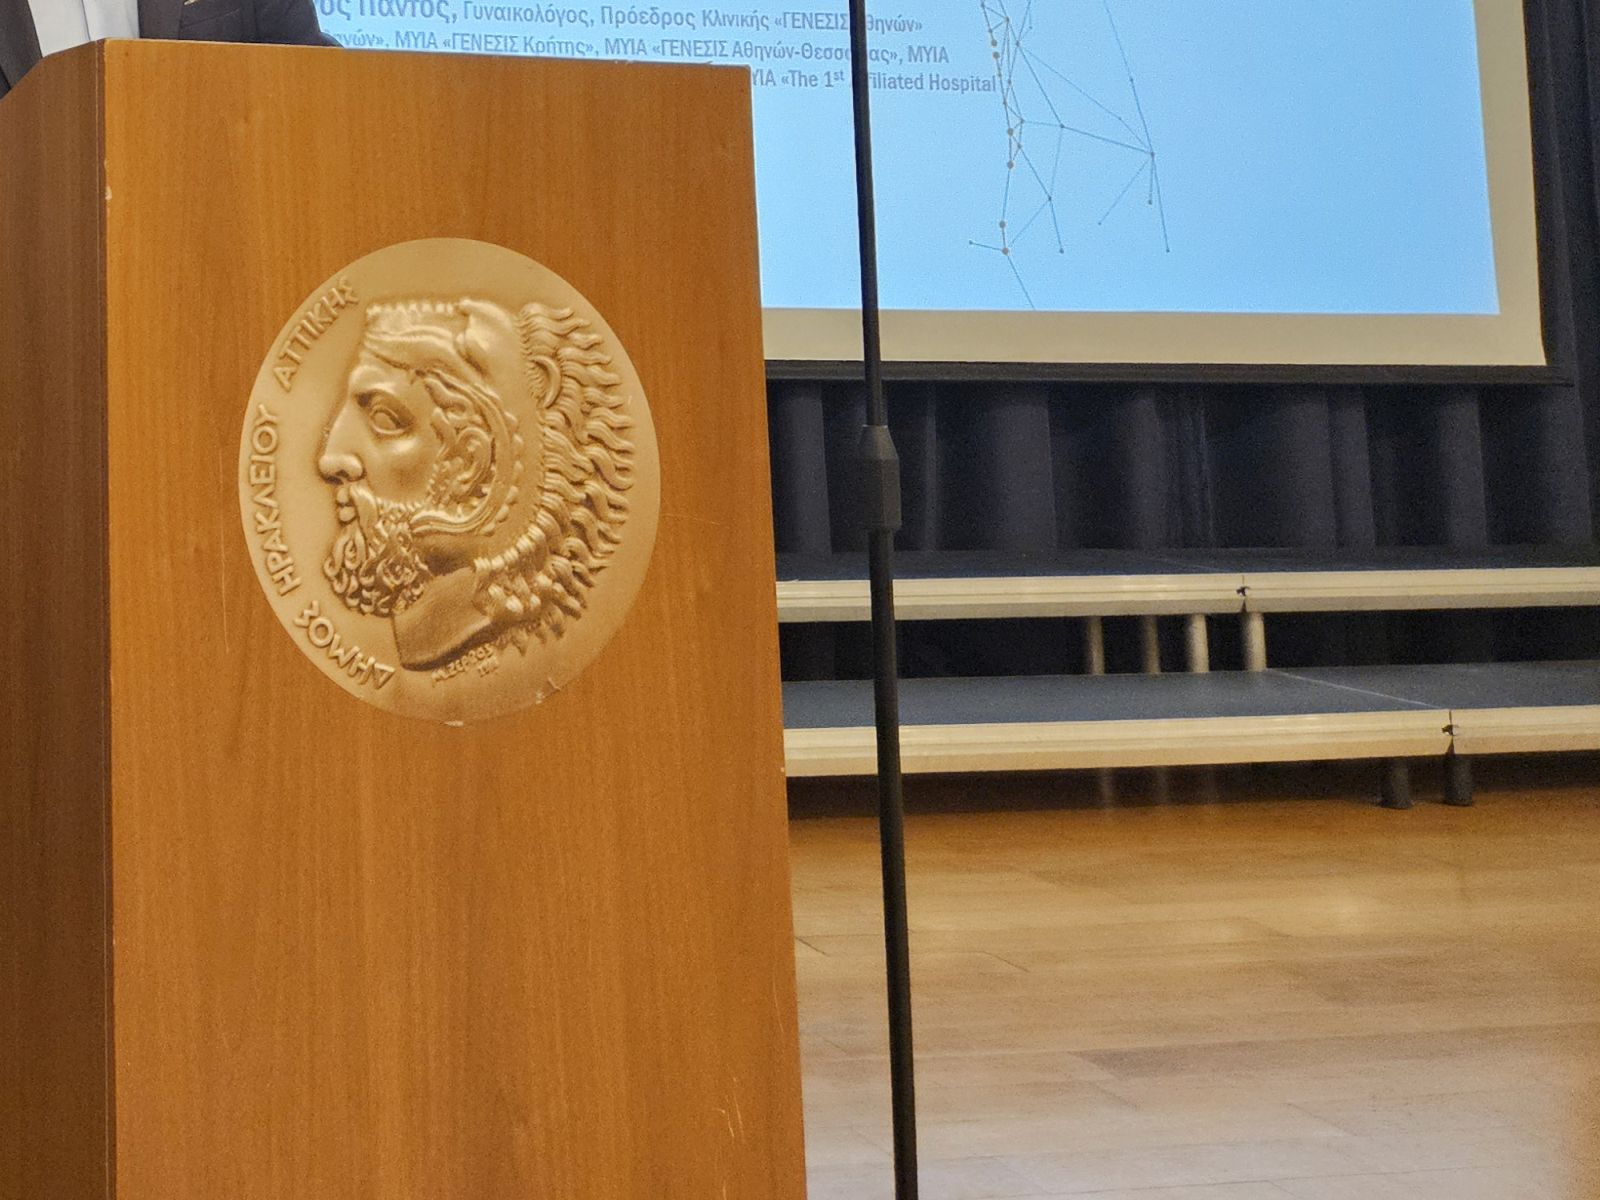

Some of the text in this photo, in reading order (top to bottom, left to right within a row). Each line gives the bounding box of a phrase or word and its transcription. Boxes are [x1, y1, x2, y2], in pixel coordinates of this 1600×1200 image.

[463, 0, 595, 28] Γυναικολόγος,
[601, 5, 695, 29] Πρόεδρος
[702, 9, 770, 31] Κλινικής
[775, 12, 849, 31] «ΓΕΝΕΣΙΣ
[866, 13, 923, 35] θηνών»
[928, 73, 997, 95] Hospital
[250, 403, 301, 597] ΗΡΑΚΛΕΙΟΥ
[293, 599, 396, 690] ΔΗΜΟΣ
